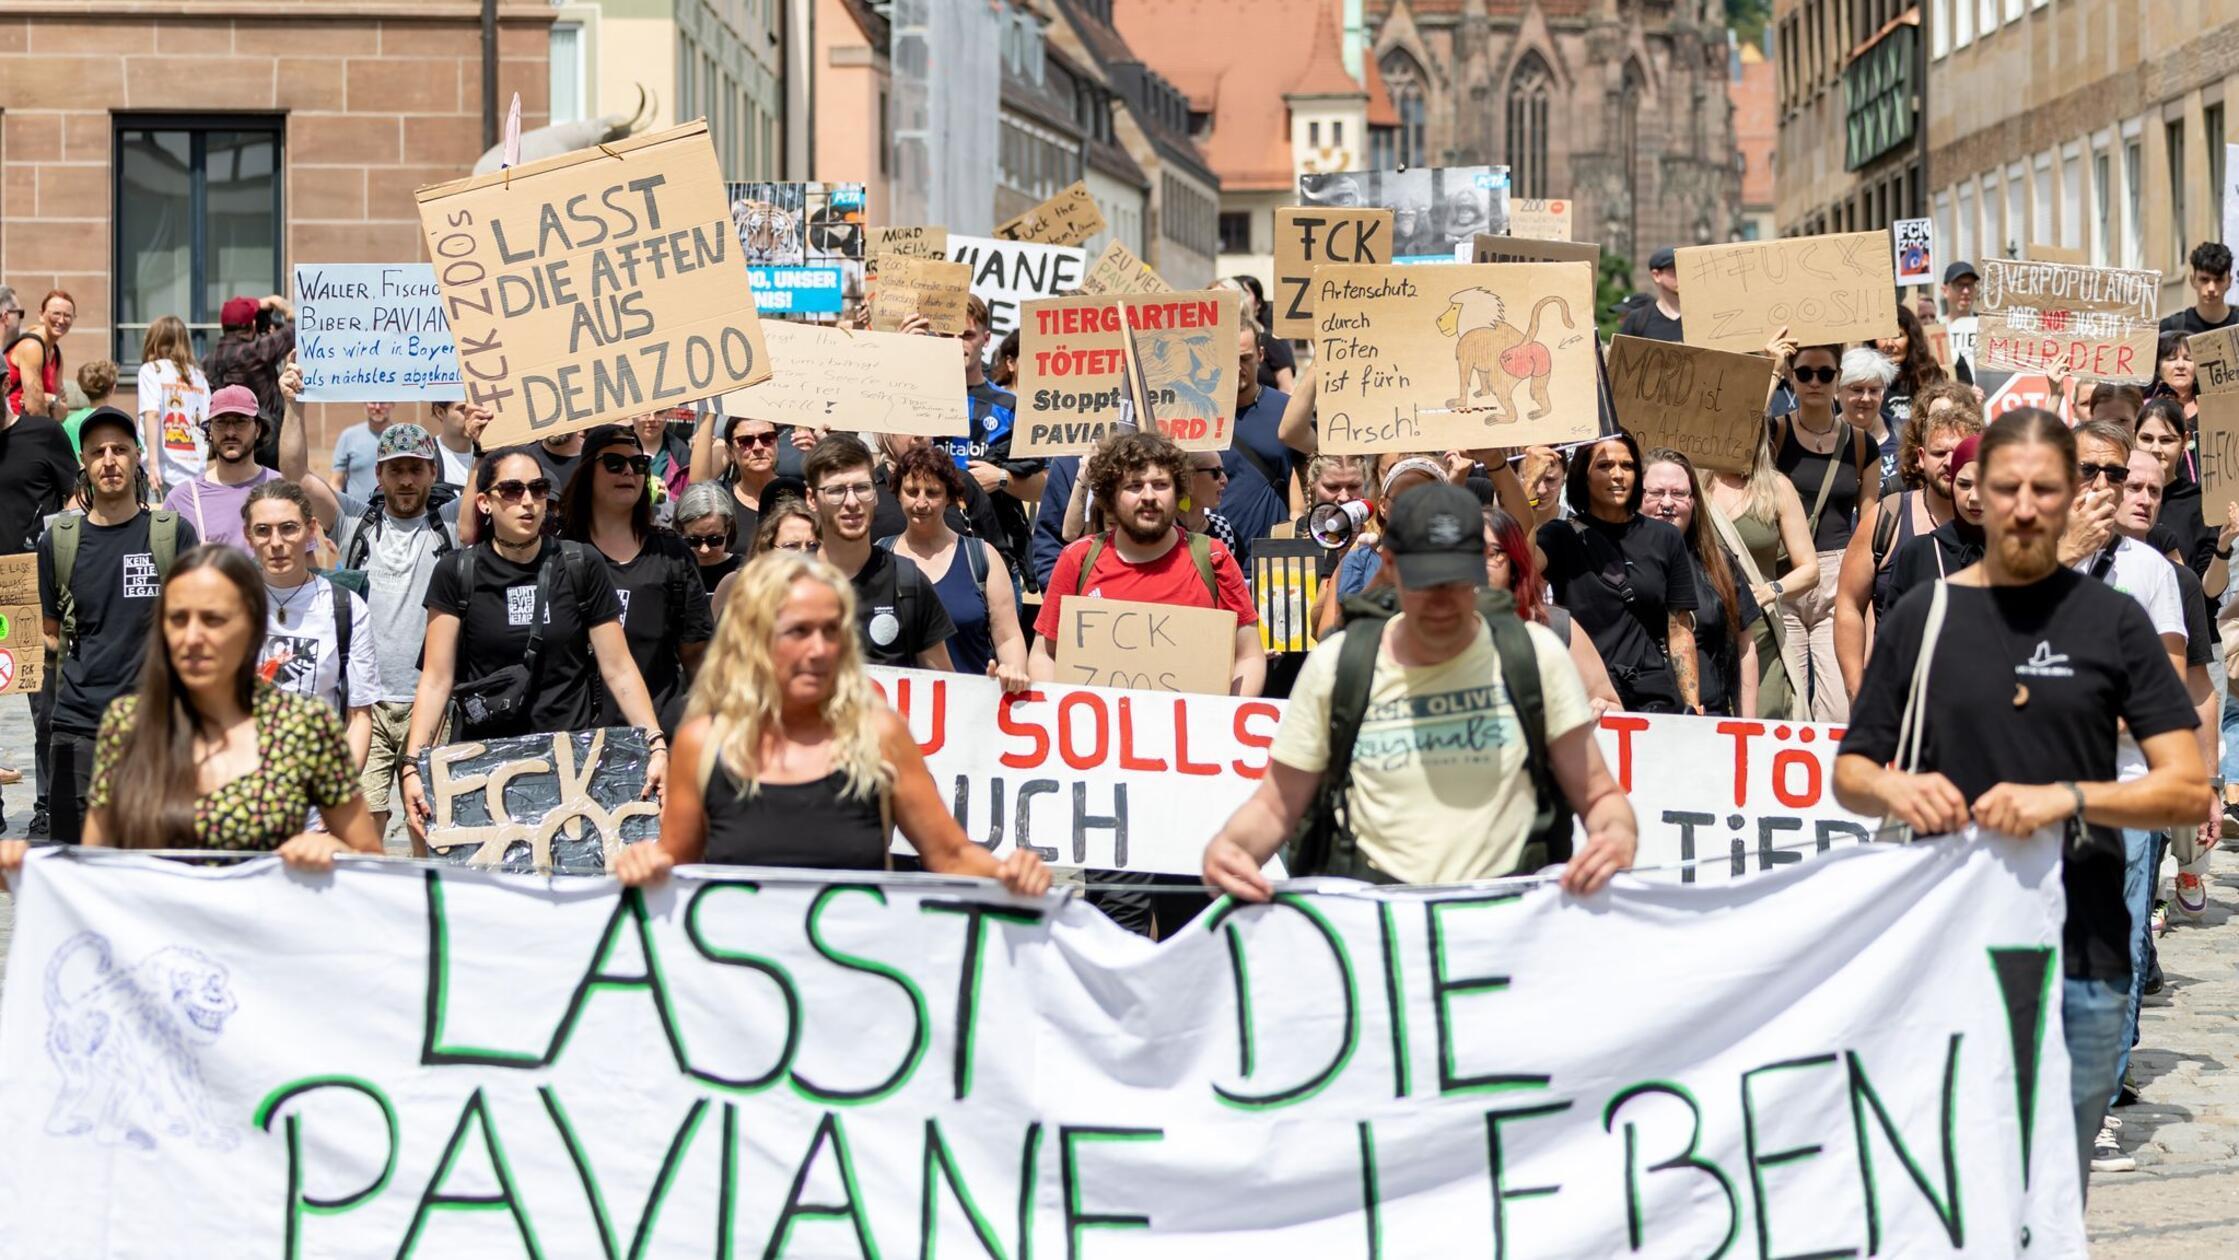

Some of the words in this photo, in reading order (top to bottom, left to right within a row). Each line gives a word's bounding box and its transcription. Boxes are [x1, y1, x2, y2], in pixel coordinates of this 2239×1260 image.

[490, 173, 666, 266] LASST
[1054, 203, 1079, 218] the
[882, 227, 923, 243] MORD
[893, 242, 931, 256] KEIN
[1047, 222, 1078, 246] tem!
[1292, 217, 1381, 264] FCK
[496, 259, 578, 319] DIE
[591, 221, 725, 300] AFFEN
[774, 270, 836, 288] UNSER
[1109, 247, 1133, 272] ZU
[1135, 269, 1168, 294] VIEL
[1321, 277, 1418, 302] Artenschutz
[1983, 262, 2161, 320] OVERPOPULATION
[569, 290, 656, 353] AUS
[1036, 301, 1218, 335] TIERGARTEN
[1321, 311, 1371, 332] durch
[2007, 305, 2039, 330] DOES
[2042, 308, 2070, 331] NOT
[2071, 311, 2135, 340] JUSTIFY
[301, 335, 335, 359] Was
[343, 339, 381, 359] wird
[391, 341, 403, 356] in
[1322, 337, 1379, 361] Töten
[1988, 337, 2134, 375] MURDER
[303, 368, 325, 386] als
[461, 327, 514, 413] FCK
[521, 353, 644, 431] DEM
[640, 327, 753, 400] ZOO
[1324, 371, 1349, 393] ist
[1612, 342, 1695, 406] MORD
[1701, 368, 1724, 411] ist
[1033, 387, 1120, 413] Stoppt
[1149, 389, 1176, 404] en
[1156, 418, 1207, 440] ORD
[1327, 403, 1423, 443] Arsch!
[1655, 413, 1741, 458] Artenschutz
[126, 557, 149, 566] KEIN
[133, 577, 148, 585] IST
[1076, 610, 1176, 650] FCK
[1601, 716, 1650, 795] T
[952, 773, 1128, 868] UCH
[420, 867, 1043, 1105] LASST
[1205, 890, 1551, 1111] DIE
[254, 1073, 1164, 1260] PAVIANE
